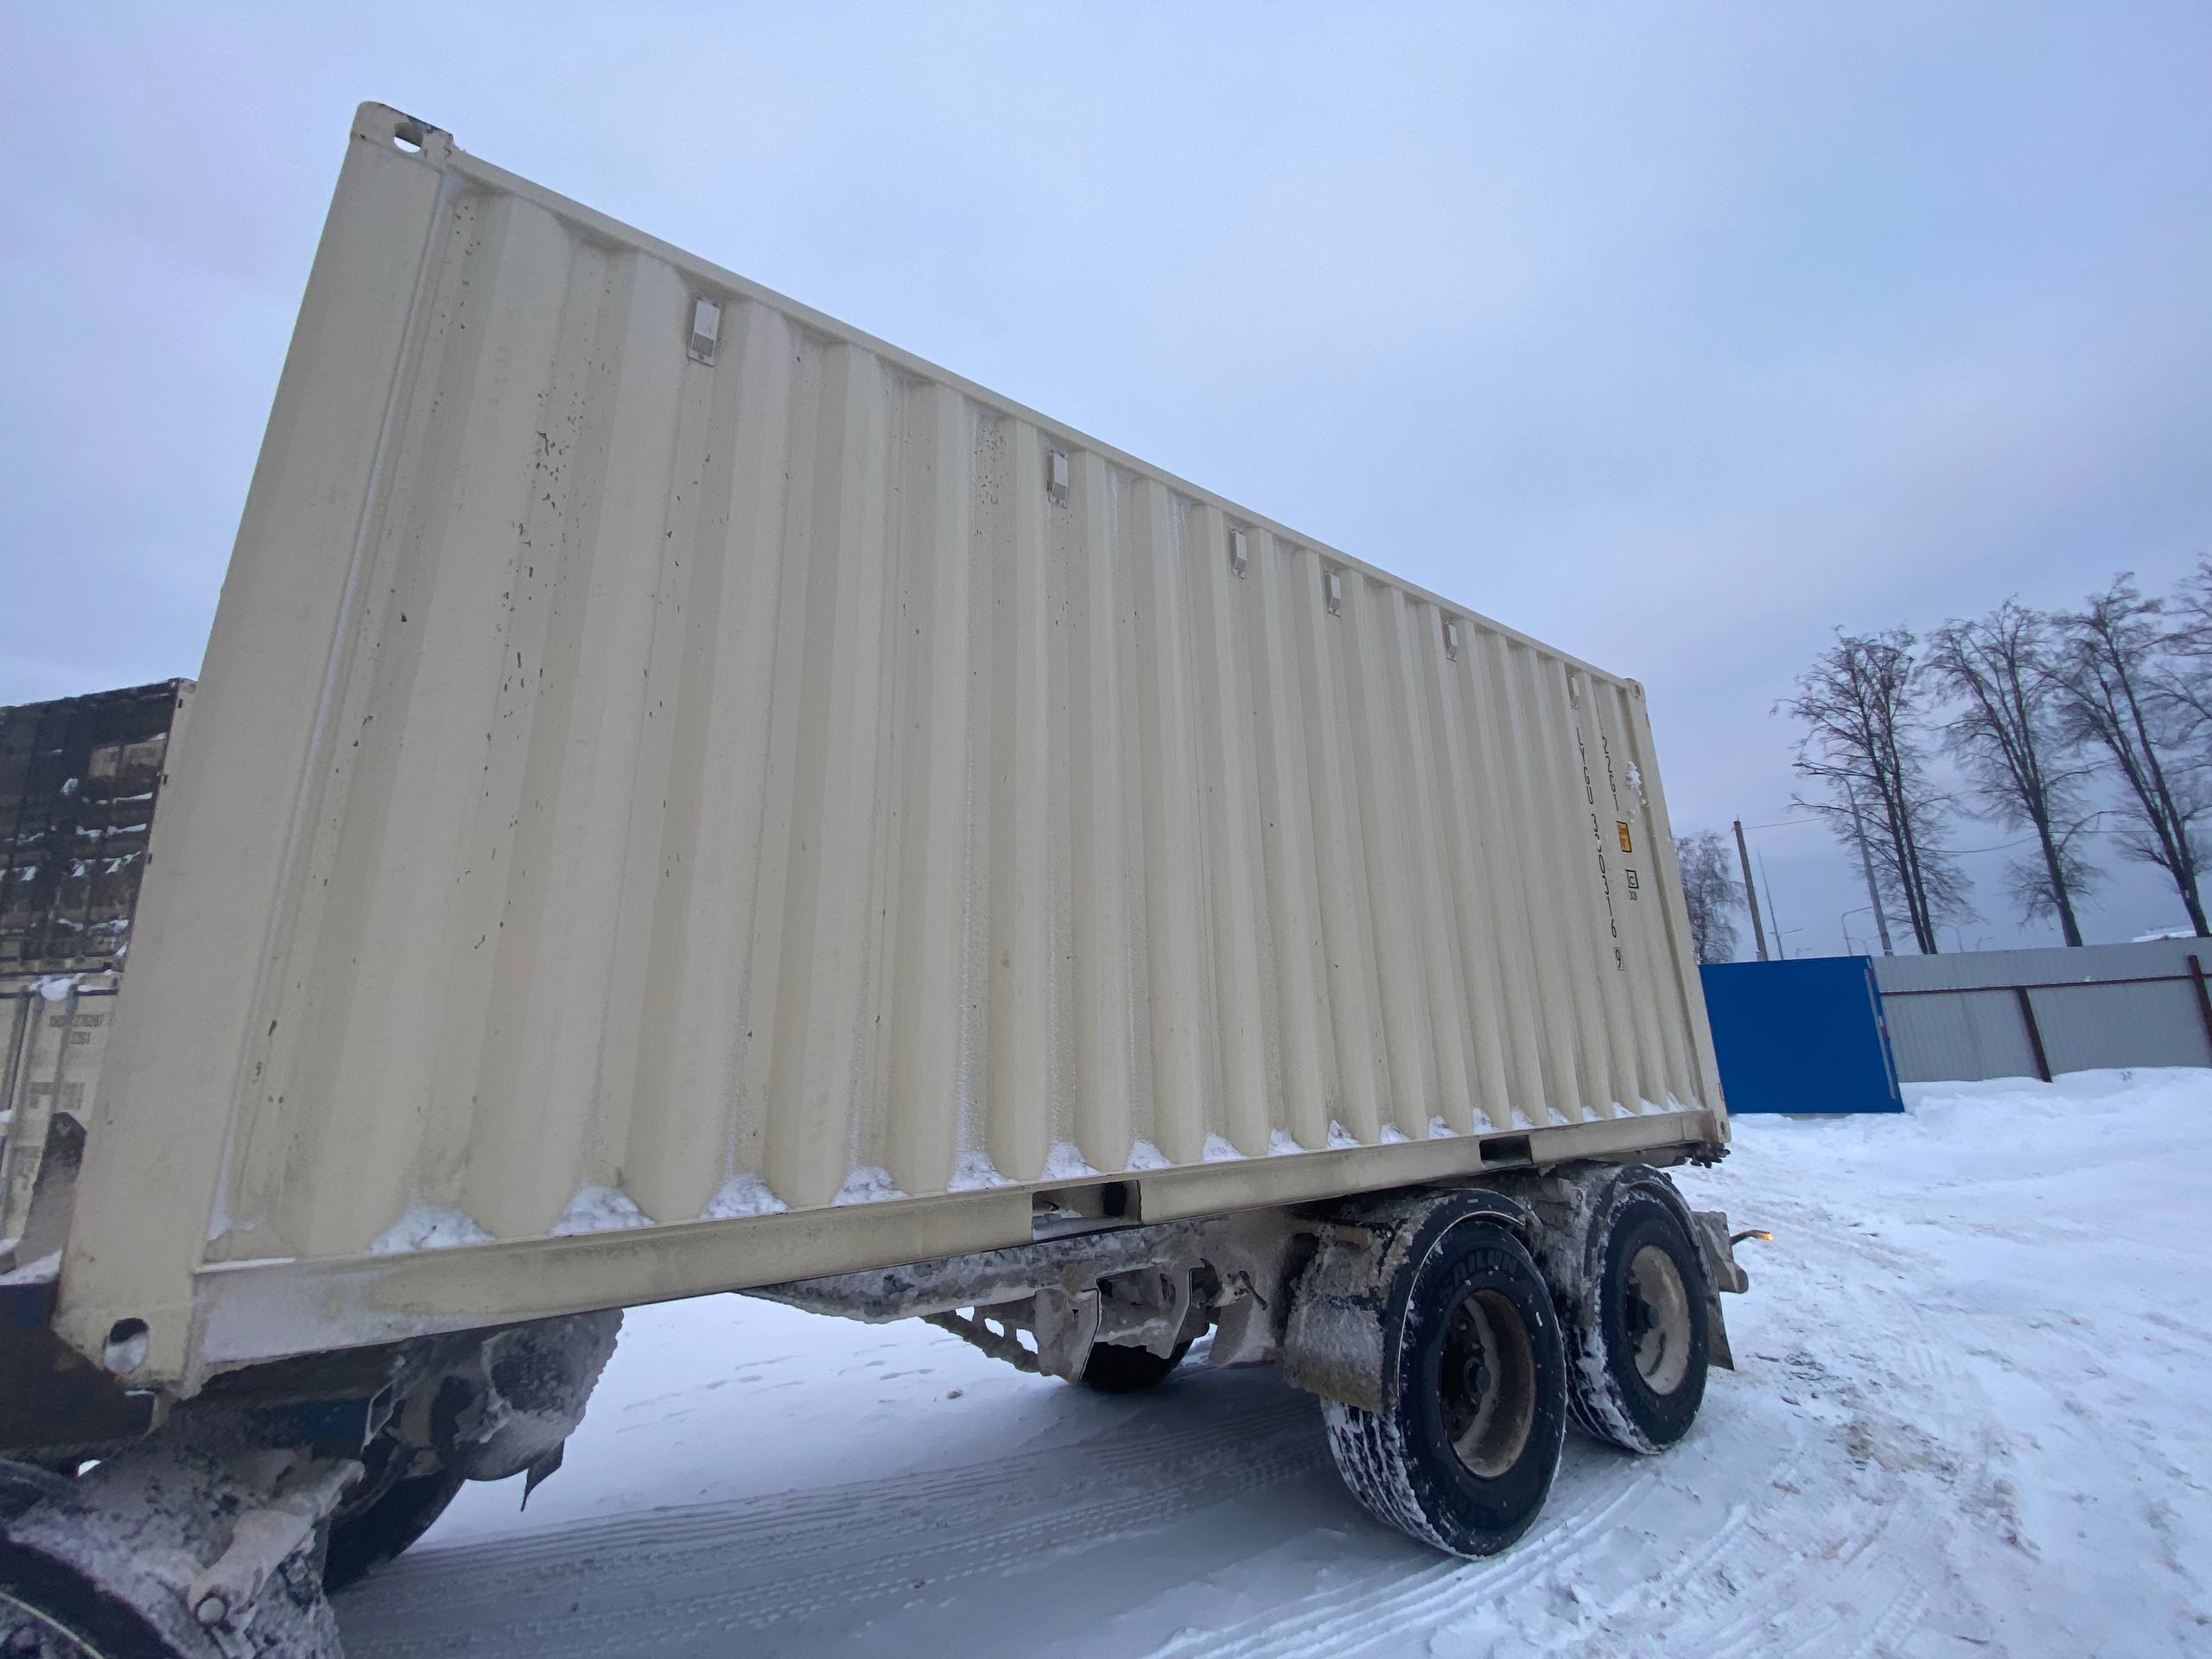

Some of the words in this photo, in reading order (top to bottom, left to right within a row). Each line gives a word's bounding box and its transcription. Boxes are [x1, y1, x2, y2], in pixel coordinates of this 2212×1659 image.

[1602, 736, 1620, 812] 22G1
[1575, 727, 1594, 805] LYGU
[1590, 813, 1618, 938] 330316
[1438, 1249, 1518, 1307] SAILUN
